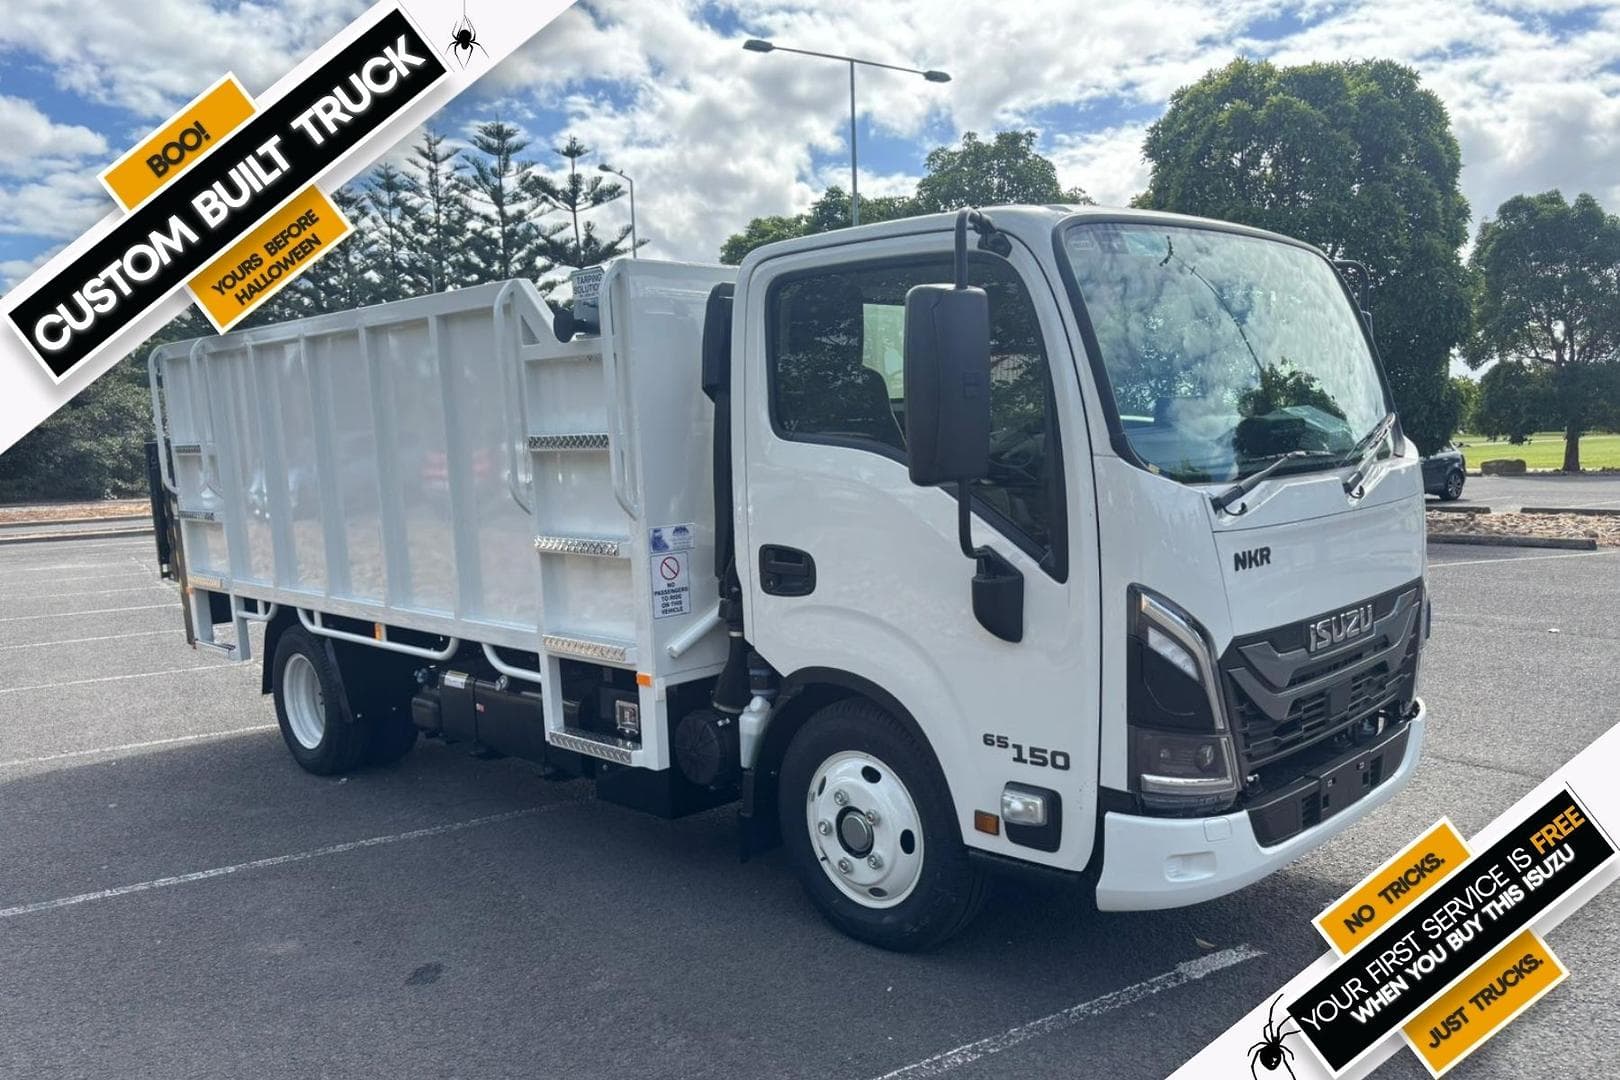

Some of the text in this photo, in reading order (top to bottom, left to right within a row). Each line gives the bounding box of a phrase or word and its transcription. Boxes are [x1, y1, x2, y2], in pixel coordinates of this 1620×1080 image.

[1234, 546, 1271, 571] NKR
[654, 586, 688, 596] PASSENGERS
[661, 606, 683, 614] VEHICLE
[1309, 604, 1373, 652] ISUZU
[983, 733, 1070, 771] 65 150
